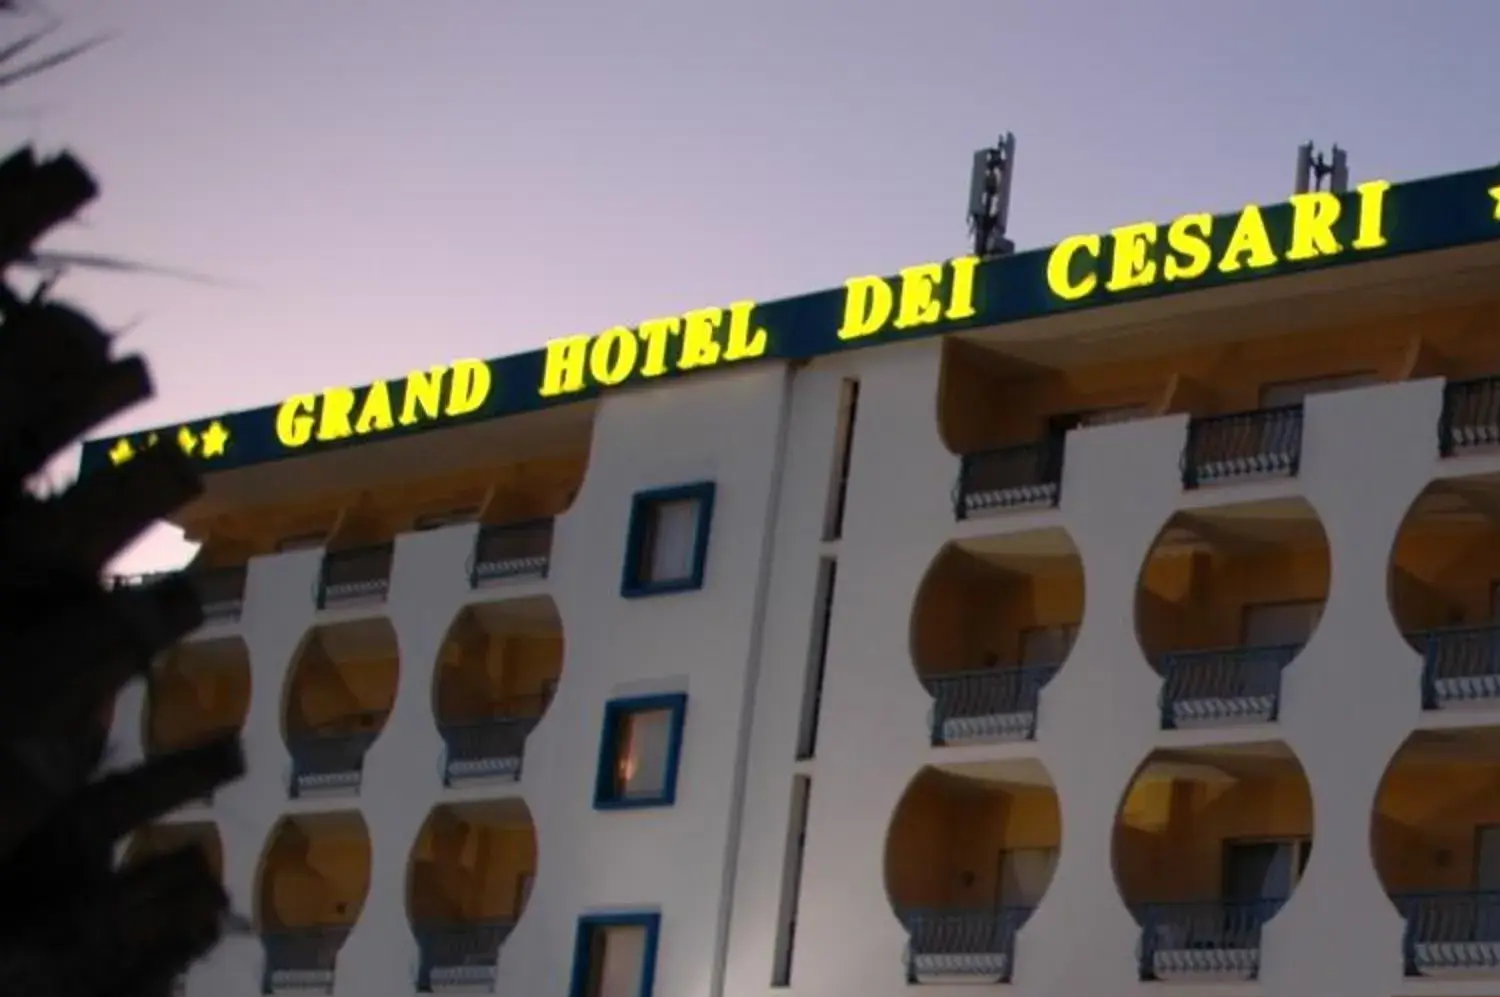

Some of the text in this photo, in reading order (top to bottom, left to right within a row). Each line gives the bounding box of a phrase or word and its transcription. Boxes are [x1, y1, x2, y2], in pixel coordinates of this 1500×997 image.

[274, 179, 1391, 449] GRAND HOTEL DEI CESARI
